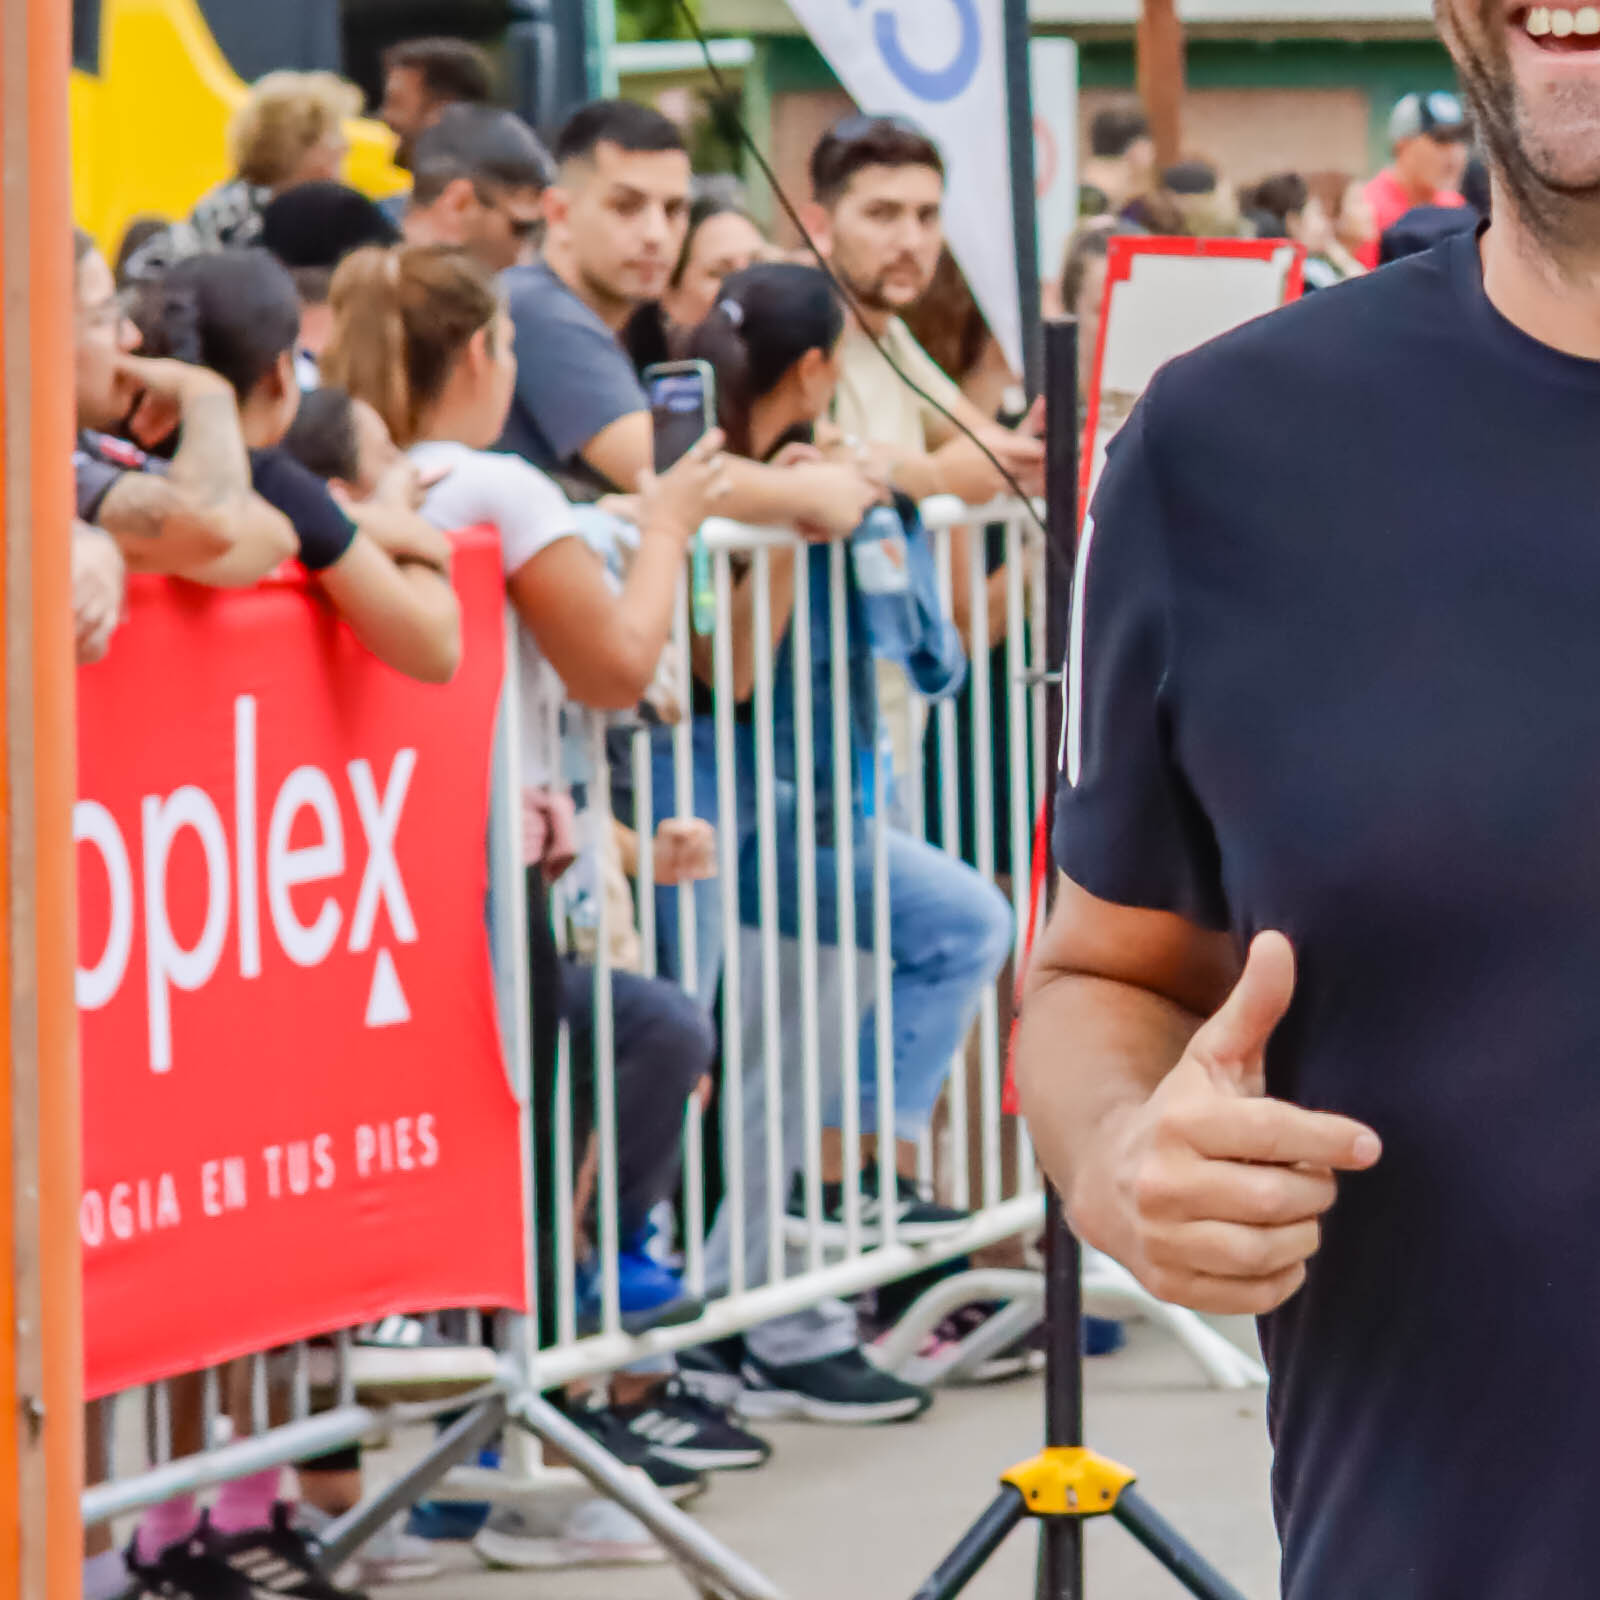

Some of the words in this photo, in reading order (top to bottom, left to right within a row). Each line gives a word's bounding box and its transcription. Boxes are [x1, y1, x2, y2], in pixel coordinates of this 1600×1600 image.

[201, 1156, 247, 1217] EN
[263, 1132, 335, 1199] TUS
[354, 1112, 439, 1178] PIES
